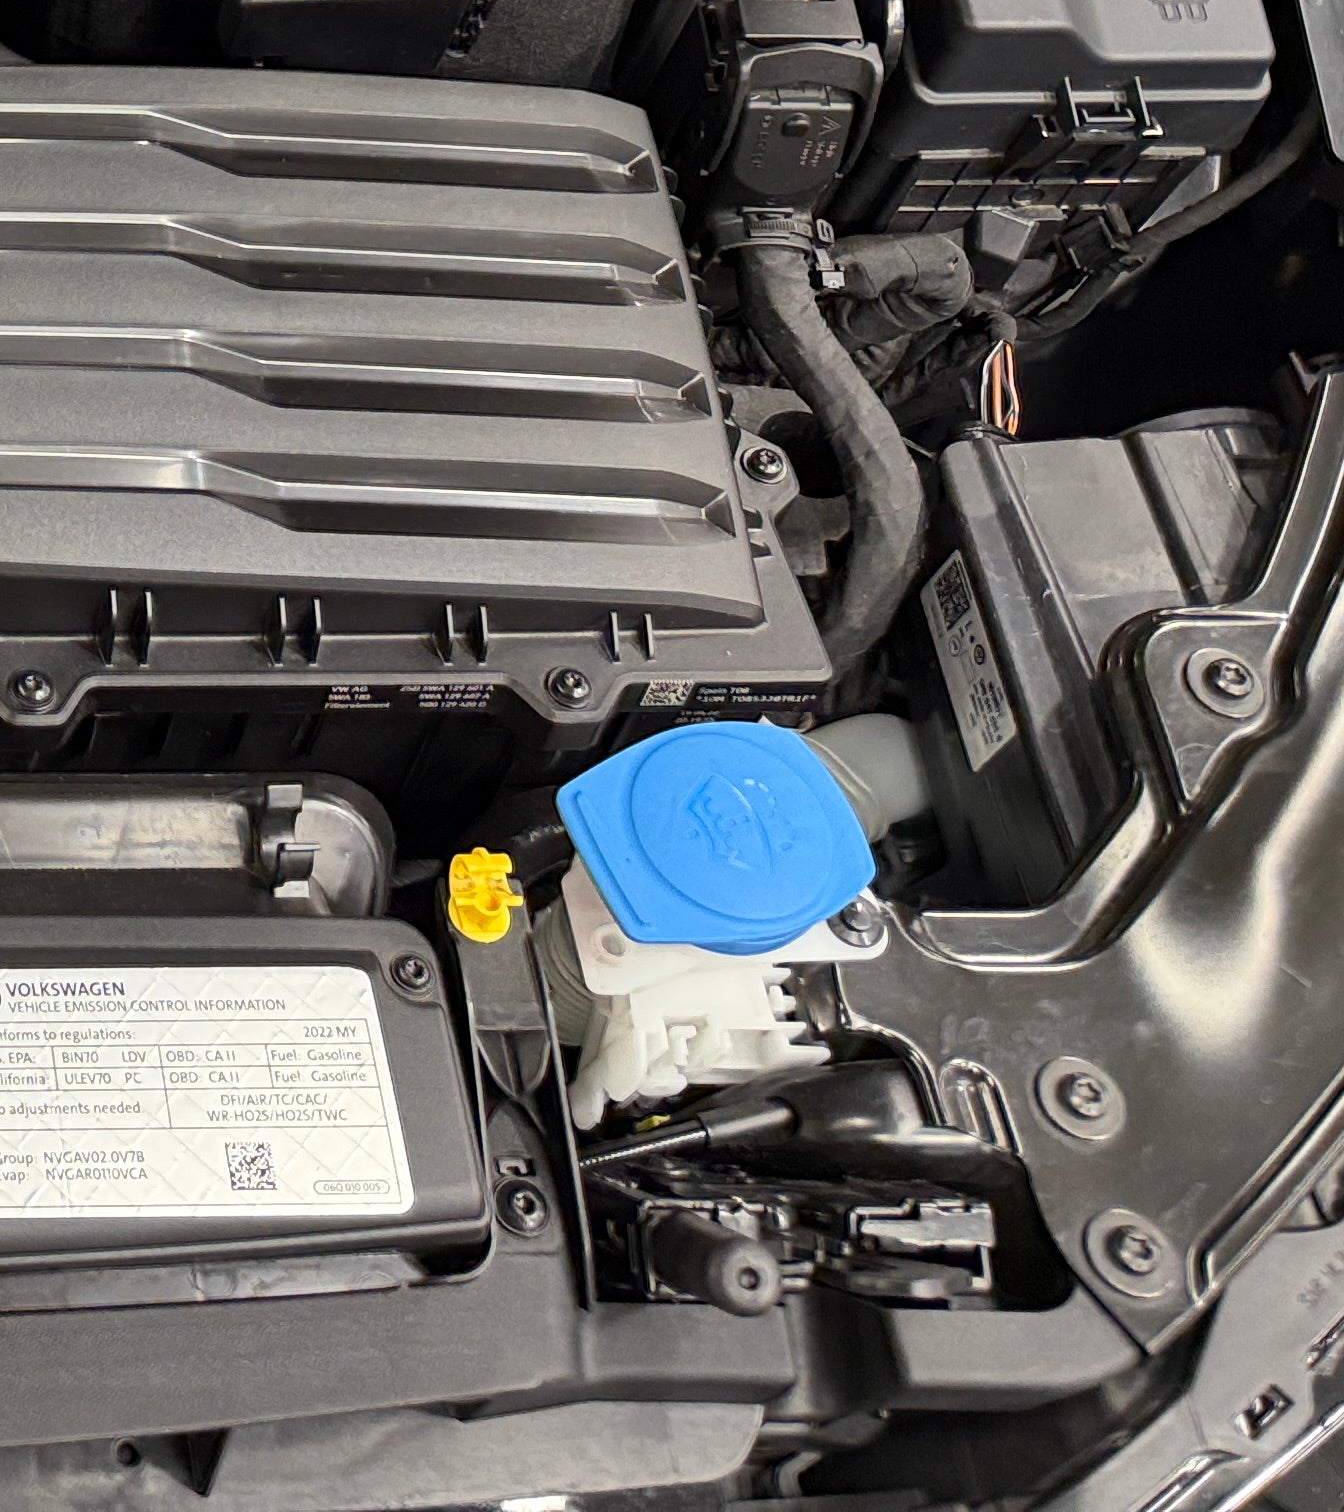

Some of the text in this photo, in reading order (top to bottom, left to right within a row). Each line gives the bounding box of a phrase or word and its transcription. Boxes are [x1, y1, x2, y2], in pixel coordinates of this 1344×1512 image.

[6, 982, 125, 996] VOLKSWAGEN
[8, 1000, 285, 1013] VEHICLE EMISSION CONTROL INFORMATION
[43, 1030, 57, 1040] to
[60, 1029, 135, 1043] regulations:
[303, 1026, 356, 1037] 2022 MY
[9, 1052, 35, 1063] EPA:
[62, 1051, 98, 1063] BIN70
[122, 1051, 146, 1062] LDV
[166, 1051, 198, 1062] OBD:
[205, 1051, 224, 1061] CA
[226, 1051, 235, 1061] II
[271, 1050, 300, 1061] Fuel:
[307, 1049, 361, 1060] Gasoline
[65, 1073, 111, 1084] ULEV70
[125, 1072, 142, 1084] PC
[169, 1072, 200, 1083] OBD:
[209, 1071, 228, 1082] CA
[230, 1072, 239, 1083] II
[274, 1071, 302, 1082] Fuel:
[311, 1071, 366, 1081] Gasoline
[9, 1103, 90, 1115] adjustments
[94, 1102, 140, 1113] needed
